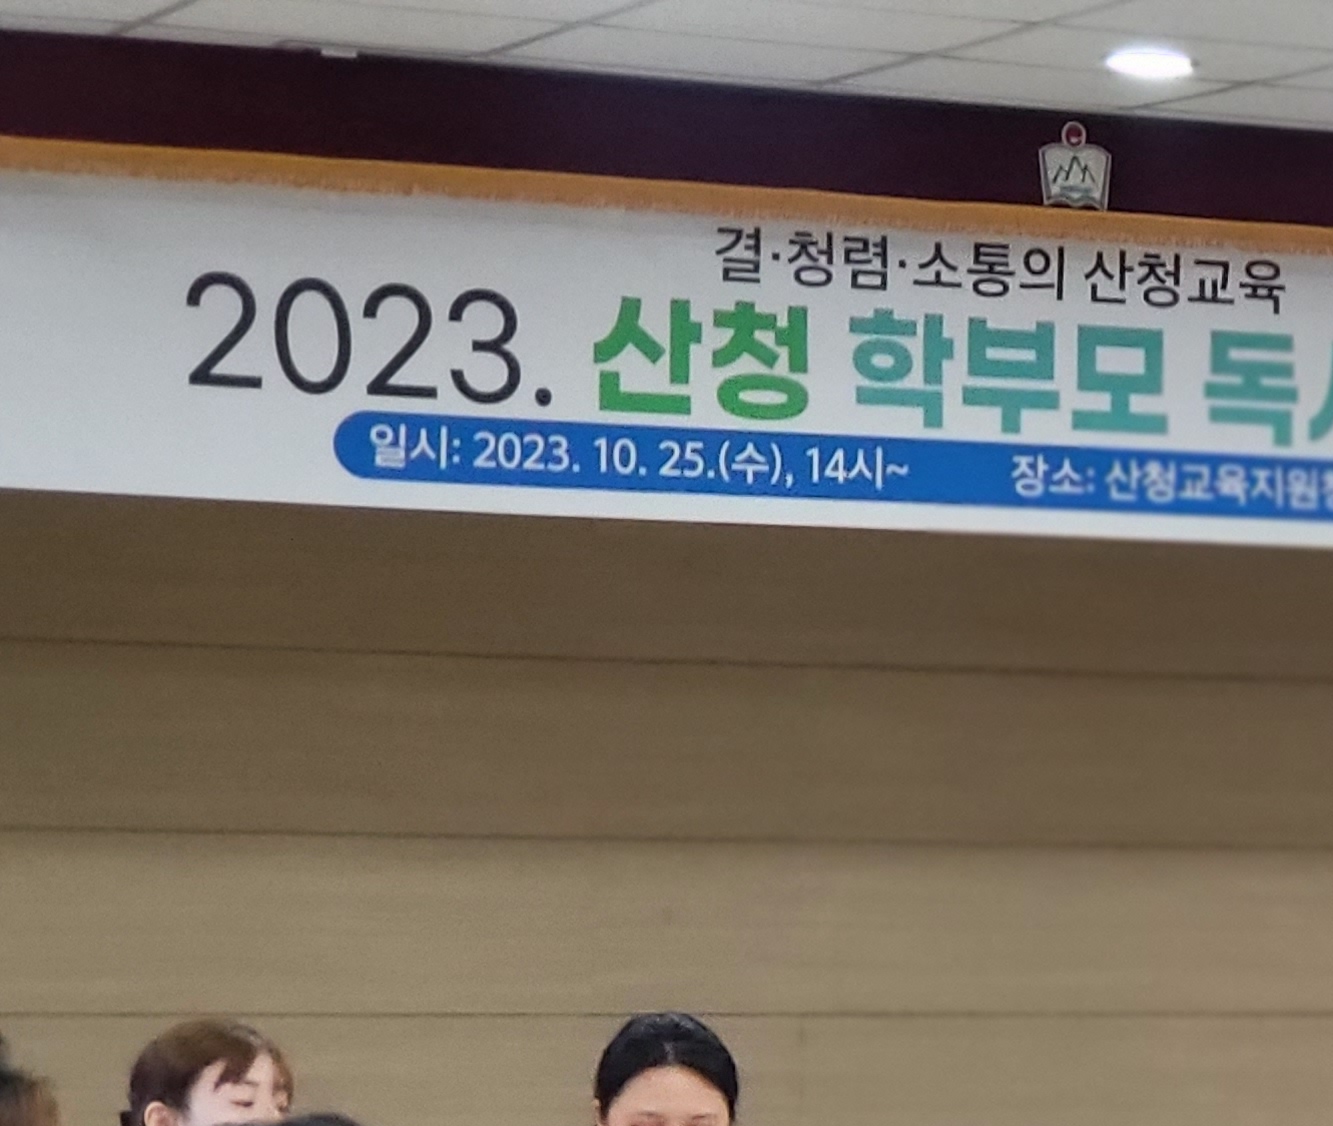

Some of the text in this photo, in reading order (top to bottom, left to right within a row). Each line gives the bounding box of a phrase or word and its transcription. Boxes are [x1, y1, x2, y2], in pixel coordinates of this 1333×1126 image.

[1084, 249, 1287, 314] 산청교육
[186, 270, 553, 408] 2023.
[592, 296, 811, 420] 산청
[848, 307, 1170, 434] 학부모
[369, 424, 462, 470] 일시:
[473, 432, 581, 473] 2023.
[593, 437, 648, 477] 10.
[1010, 452, 1096, 500] 장소:
